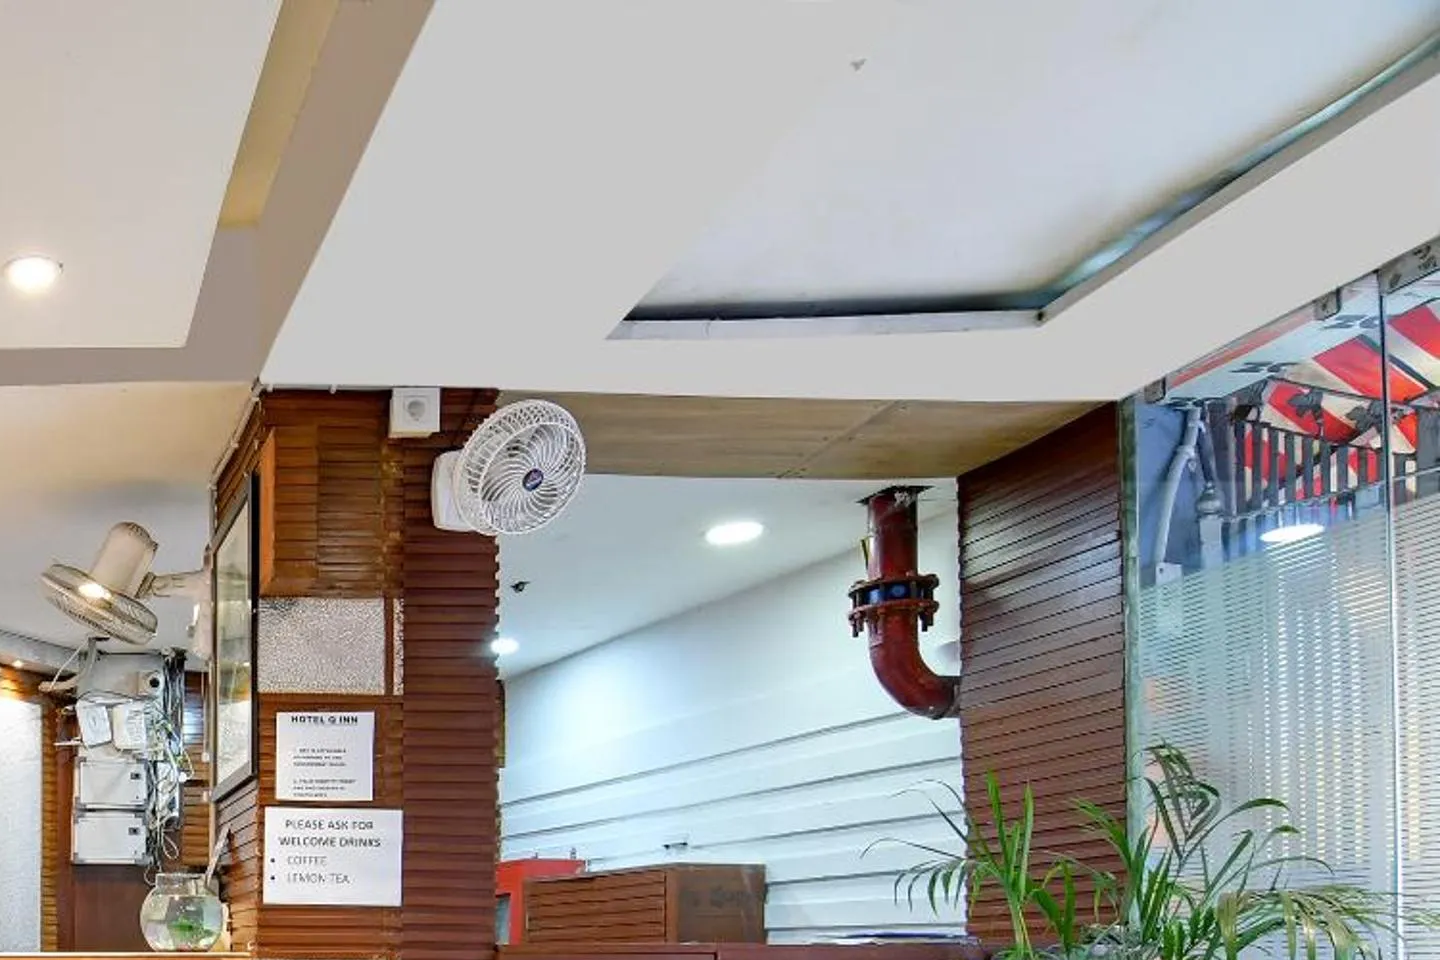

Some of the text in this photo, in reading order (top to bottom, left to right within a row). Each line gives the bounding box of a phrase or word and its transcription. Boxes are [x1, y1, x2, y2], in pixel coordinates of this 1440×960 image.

[291, 716, 325, 724] HOTEL
[339, 716, 358, 724] INN
[285, 819, 373, 830] PLEASE ASK FOR
[278, 836, 381, 847] WELCOME DRINKS
[287, 855, 327, 866] COFFEE
[287, 872, 351, 884] LEMON TEA
